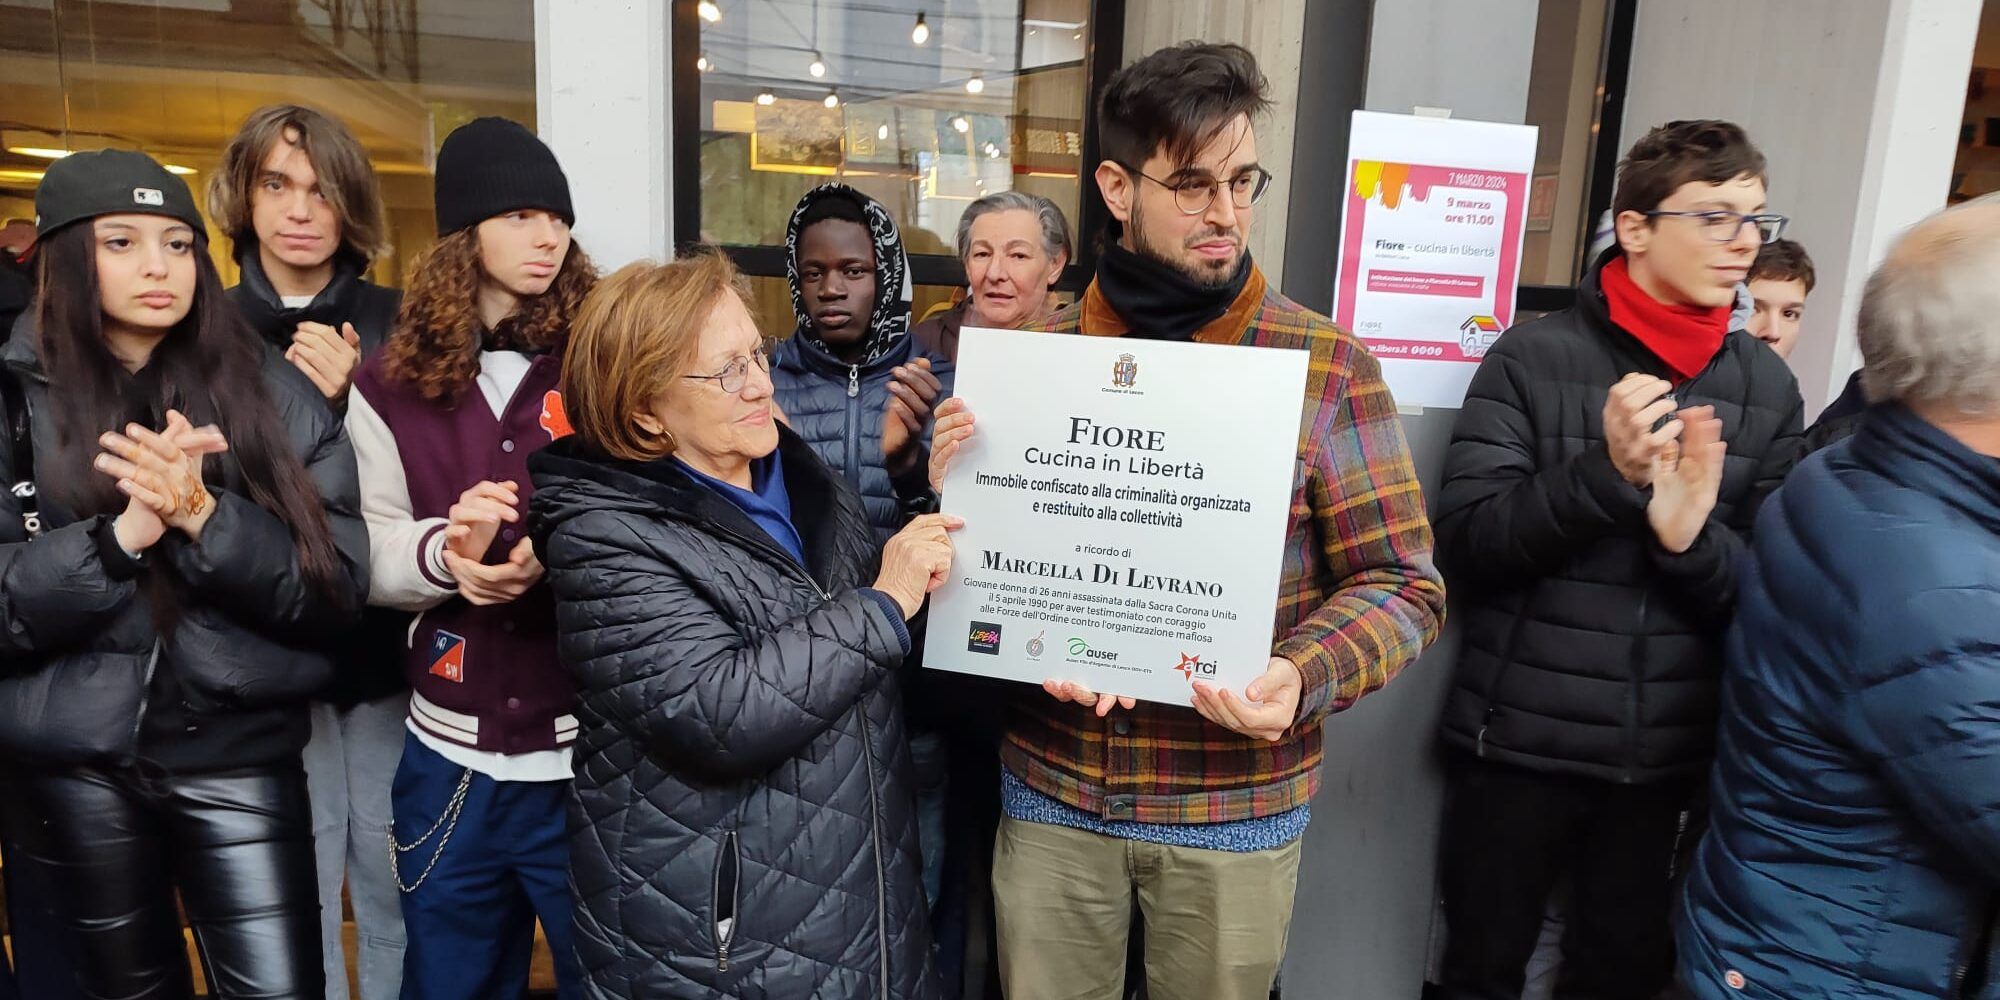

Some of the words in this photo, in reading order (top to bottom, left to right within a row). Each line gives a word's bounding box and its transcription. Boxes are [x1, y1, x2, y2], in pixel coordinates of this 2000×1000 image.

[1456, 172, 1484, 188] MARZO
[1484, 176, 1507, 190] 2024
[1447, 197, 1454, 207] 9
[1456, 200, 1491, 210] marzo
[1445, 214, 1464, 223] ore
[1464, 214, 1494, 226] 11.00
[1375, 239, 1405, 251] Fiore
[1414, 244, 1448, 255] cucina
[1450, 244, 1459, 254] in
[1461, 244, 1495, 258] libertà
[1066, 416, 1165, 452] FIORE
[1024, 447, 1095, 470] Cucina
[1102, 454, 1120, 472] in
[1128, 456, 1204, 480] Libertà
[976, 471, 1028, 490] Immobile
[1030, 478, 1088, 496] confiscato
[1092, 483, 1112, 498] alla
[1114, 485, 1177, 505] criminalità
[1180, 494, 1251, 513] organizzata
[1032, 502, 1040, 512] e
[1042, 500, 1094, 518] restituito
[1097, 506, 1117, 520] alla
[1120, 508, 1182, 528] collettività
[1075, 544, 1081, 552] a
[1084, 544, 1120, 556] ricordo
[1122, 548, 1132, 558] di
[980, 550, 1084, 581] MARCELLA
[1126, 568, 1223, 598] LEVRANO
[964, 578, 998, 590] Giovane
[1000, 582, 1026, 594] donna
[1029, 586, 1038, 595] di
[1039, 587, 1050, 596] 26
[1052, 590, 1071, 600] anni
[1072, 594, 1122, 606] assassinata
[1124, 598, 1146, 610] dalla
[1148, 601, 1174, 612] Sacra
[1176, 604, 1209, 618] Corona
[1212, 608, 1237, 621] Unita
[988, 593, 994, 602] il
[996, 594, 1000, 602] 5
[1002, 596, 1026, 607] aprile
[1028, 598, 1048, 608] 1990
[1049, 600, 1064, 612] per
[1066, 604, 1086, 614] aver
[1087, 605, 1144, 622] testimoniato
[1146, 614, 1162, 624] con
[1164, 617, 1206, 631] coraggio
[980, 604, 994, 614] alle
[997, 606, 1020, 617] Forze
[1022, 610, 1070, 624] dell'Ordine
[1071, 616, 1100, 628] contro
[1102, 620, 1174, 638] l'organizzazione
[1176, 631, 1212, 643] mafiosa
[1086, 648, 1118, 661] auser
[1183, 660, 1217, 675] arci
